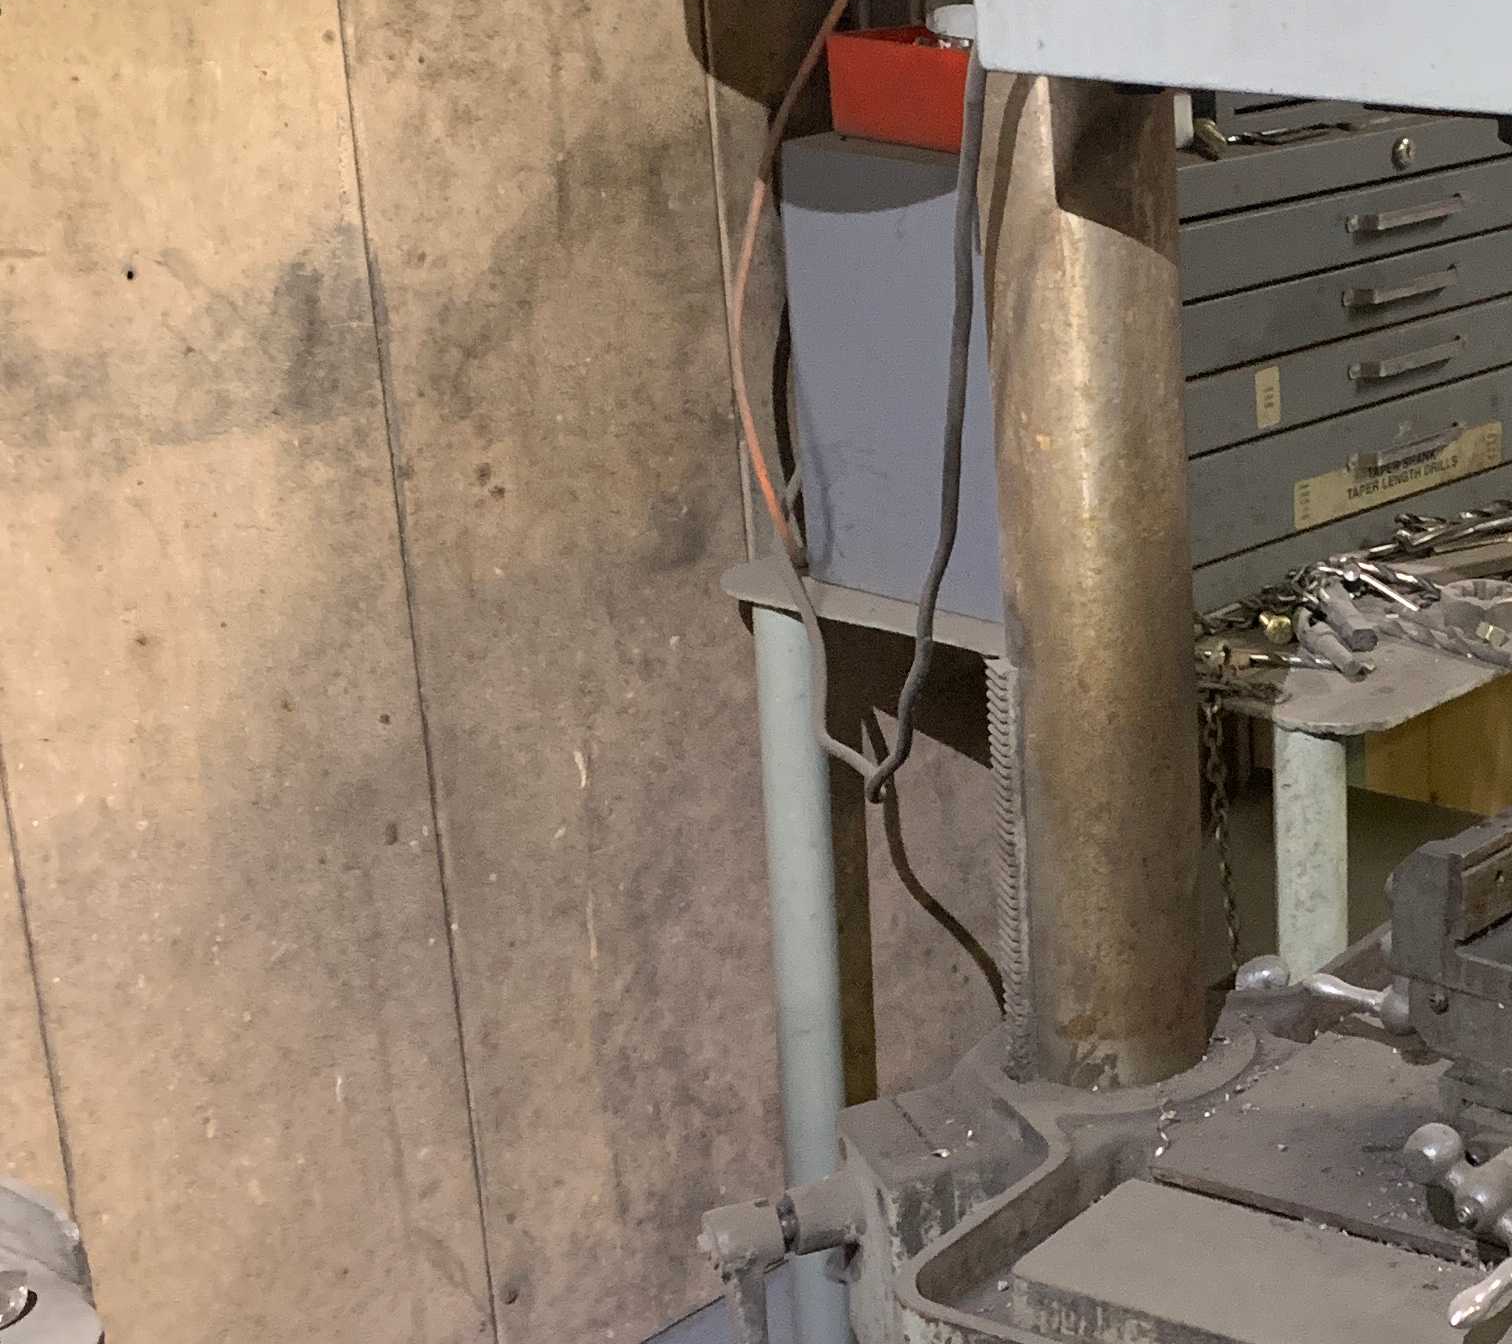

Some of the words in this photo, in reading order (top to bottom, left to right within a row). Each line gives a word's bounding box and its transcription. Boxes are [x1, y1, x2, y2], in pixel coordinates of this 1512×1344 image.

[1347, 482, 1380, 499] TAPER
[1382, 468, 1422, 490] LENGTH
[1424, 455, 1458, 477] DRILLS
